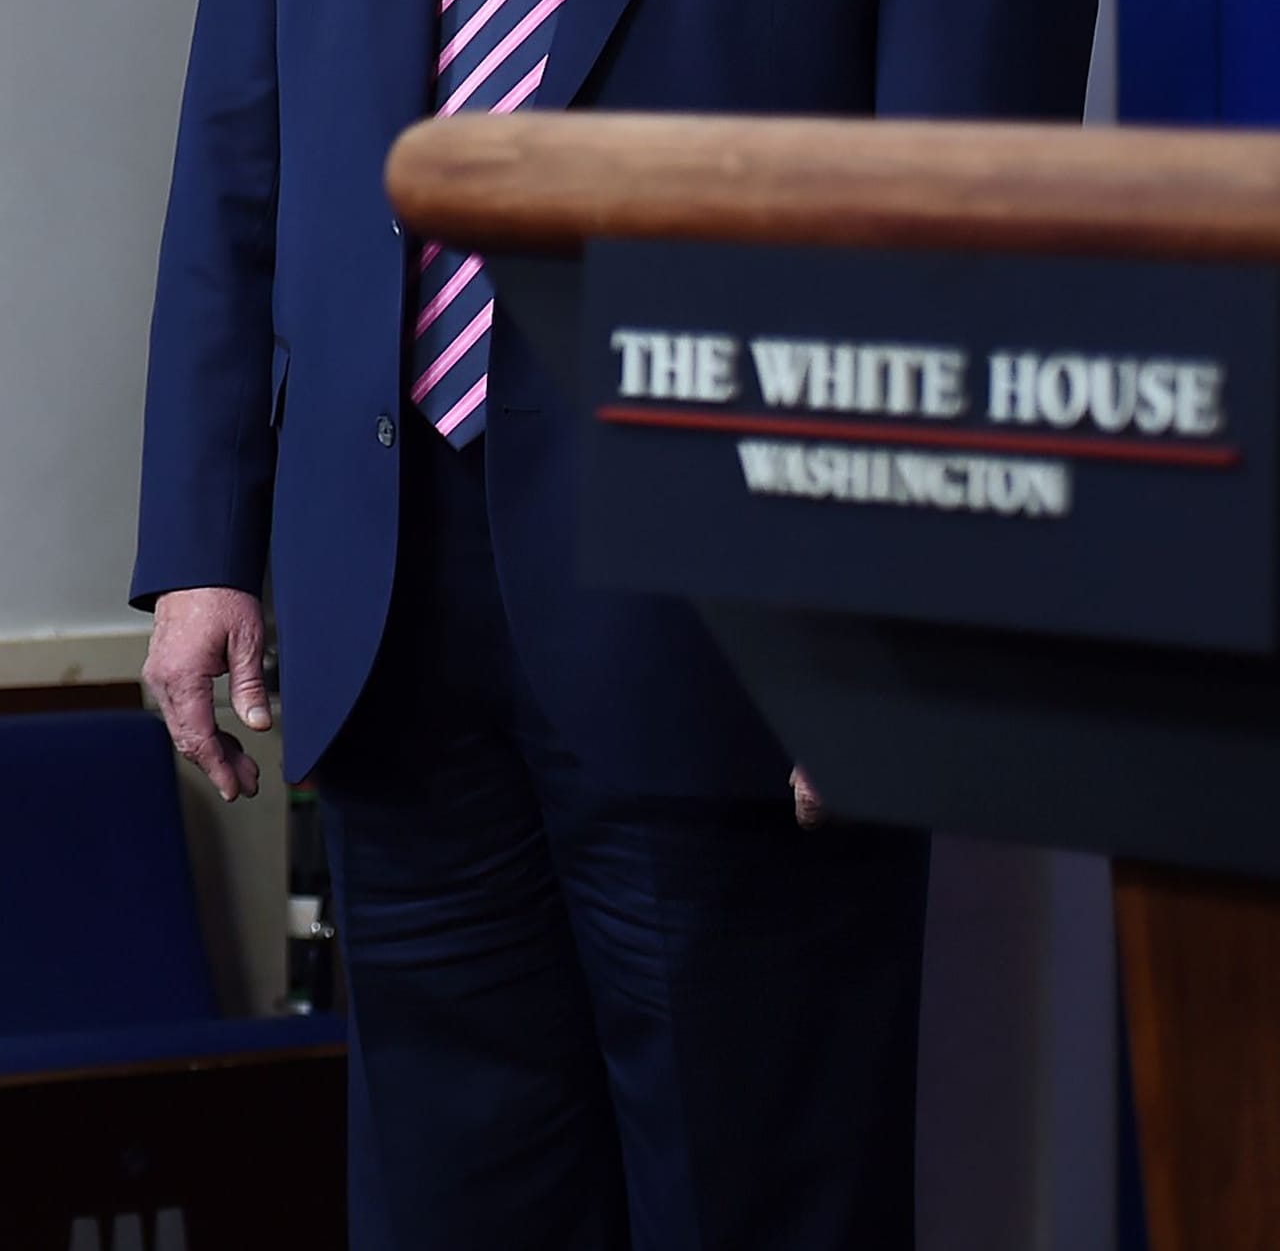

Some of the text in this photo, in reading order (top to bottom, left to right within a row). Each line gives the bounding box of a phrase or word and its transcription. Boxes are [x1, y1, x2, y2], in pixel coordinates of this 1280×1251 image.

[610, 328, 1225, 435] THE WHITE HOUSE
[738, 440, 1072, 516] WASHINGTON
